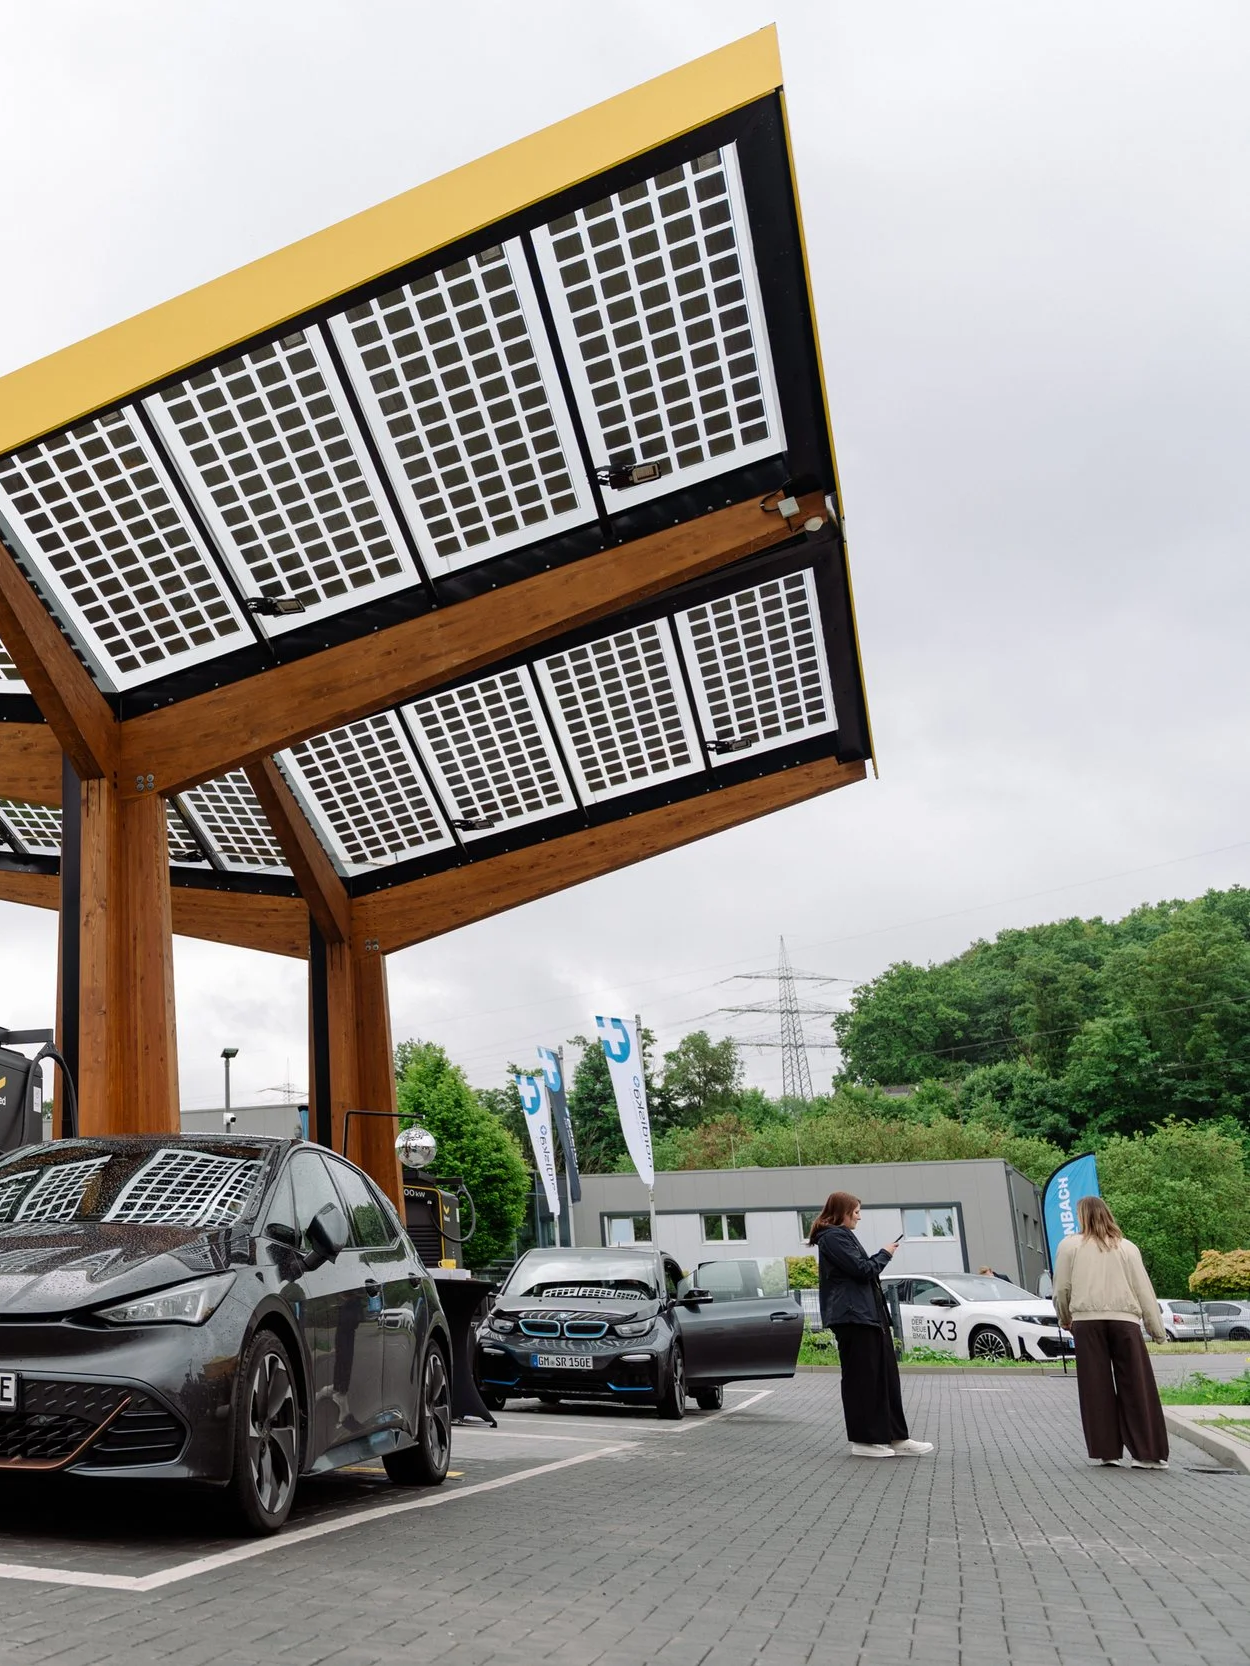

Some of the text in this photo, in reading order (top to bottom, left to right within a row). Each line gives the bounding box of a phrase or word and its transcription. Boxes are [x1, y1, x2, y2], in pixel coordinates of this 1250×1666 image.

[911, 1318, 923, 1326] DER
[926, 1319, 958, 1342] iX3
[538, 1356, 550, 1366] GM
[555, 1357, 567, 1367] SR
[569, 1357, 592, 1368] 150E
